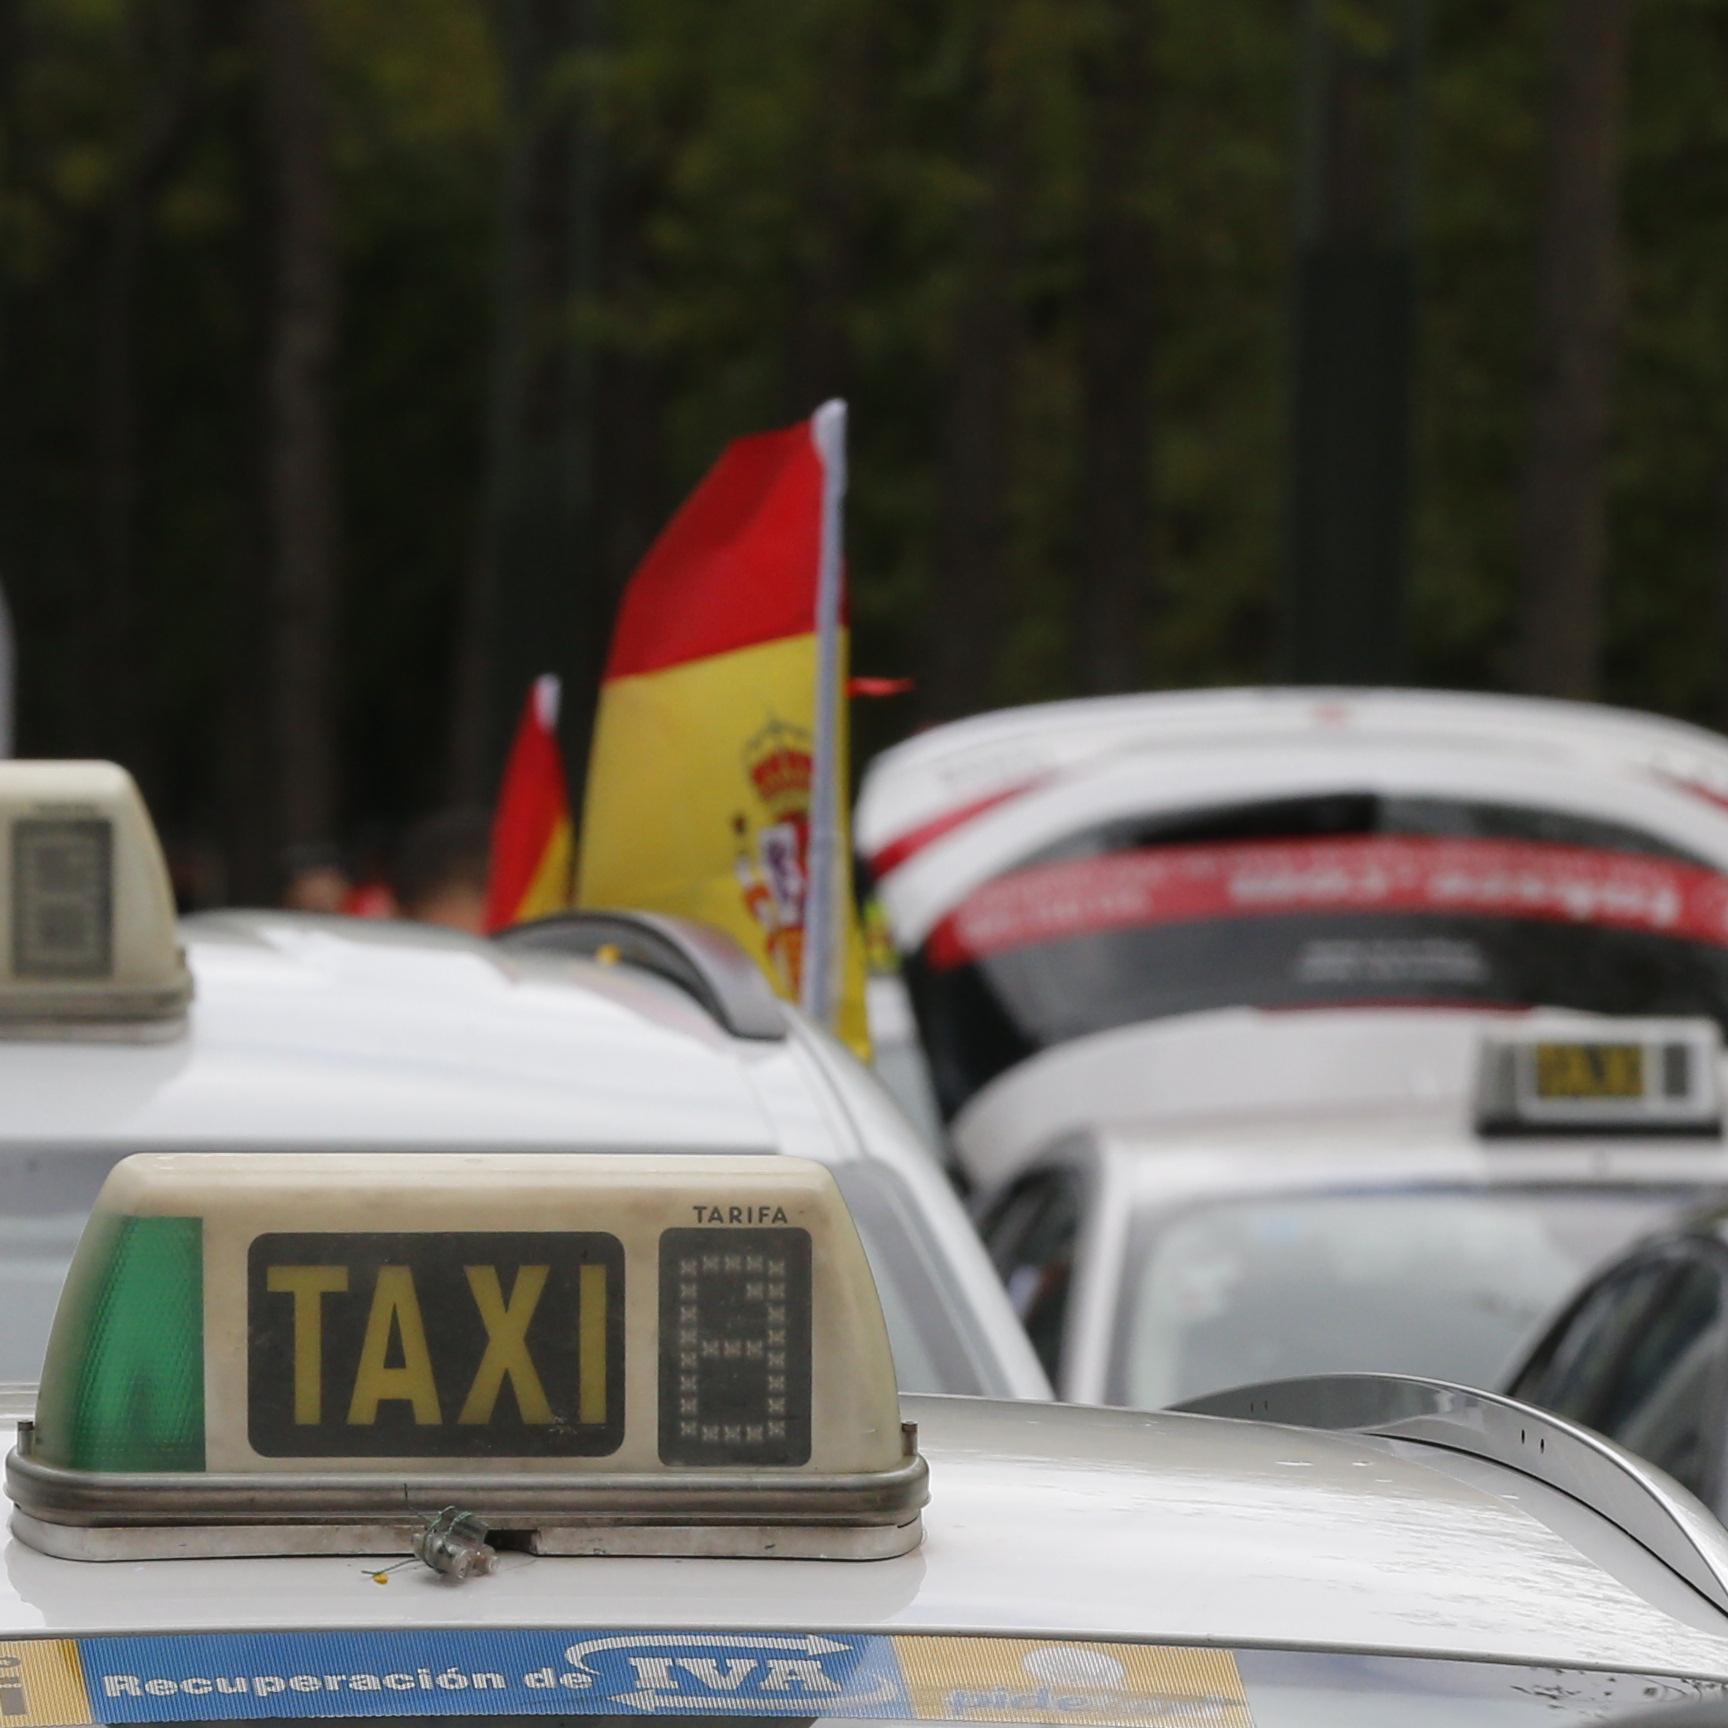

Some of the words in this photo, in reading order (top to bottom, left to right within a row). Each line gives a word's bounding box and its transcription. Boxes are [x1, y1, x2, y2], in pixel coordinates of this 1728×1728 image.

[691, 1204, 790, 1226] TARIFA
[266, 1262, 608, 1426] TAXI
[104, 1664, 507, 1698] Recuperación
[524, 1664, 594, 1692] de
[628, 1656, 842, 1694] IVA
